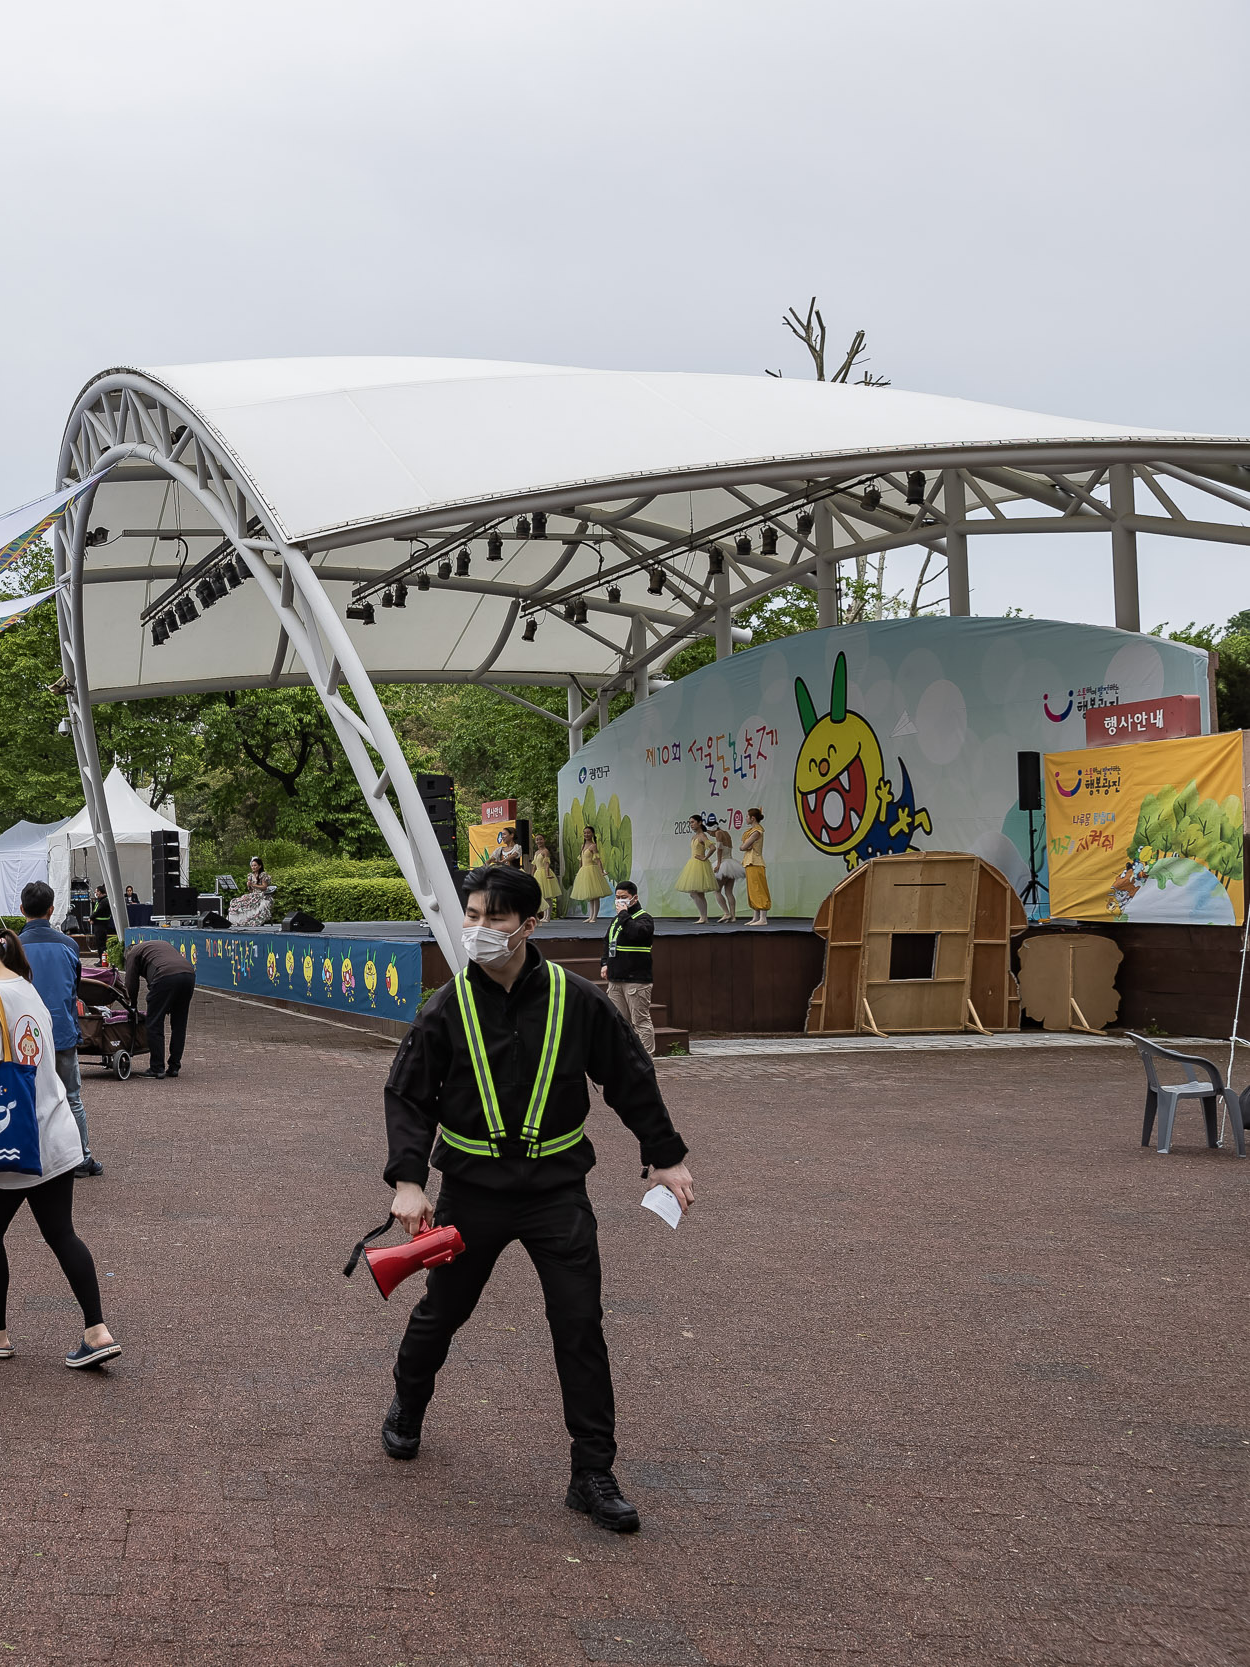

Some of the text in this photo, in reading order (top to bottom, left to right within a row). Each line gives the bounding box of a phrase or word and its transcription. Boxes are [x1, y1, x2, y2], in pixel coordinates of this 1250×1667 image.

[1103, 709, 1164, 736] 행사안내
[645, 741, 681, 767] 제10회
[588, 765, 611, 781] 광진구
[1085, 776, 1121, 796] 행복광진
[1073, 813, 1091, 826] 나루몽
[1076, 830, 1115, 852] 지켜줘
